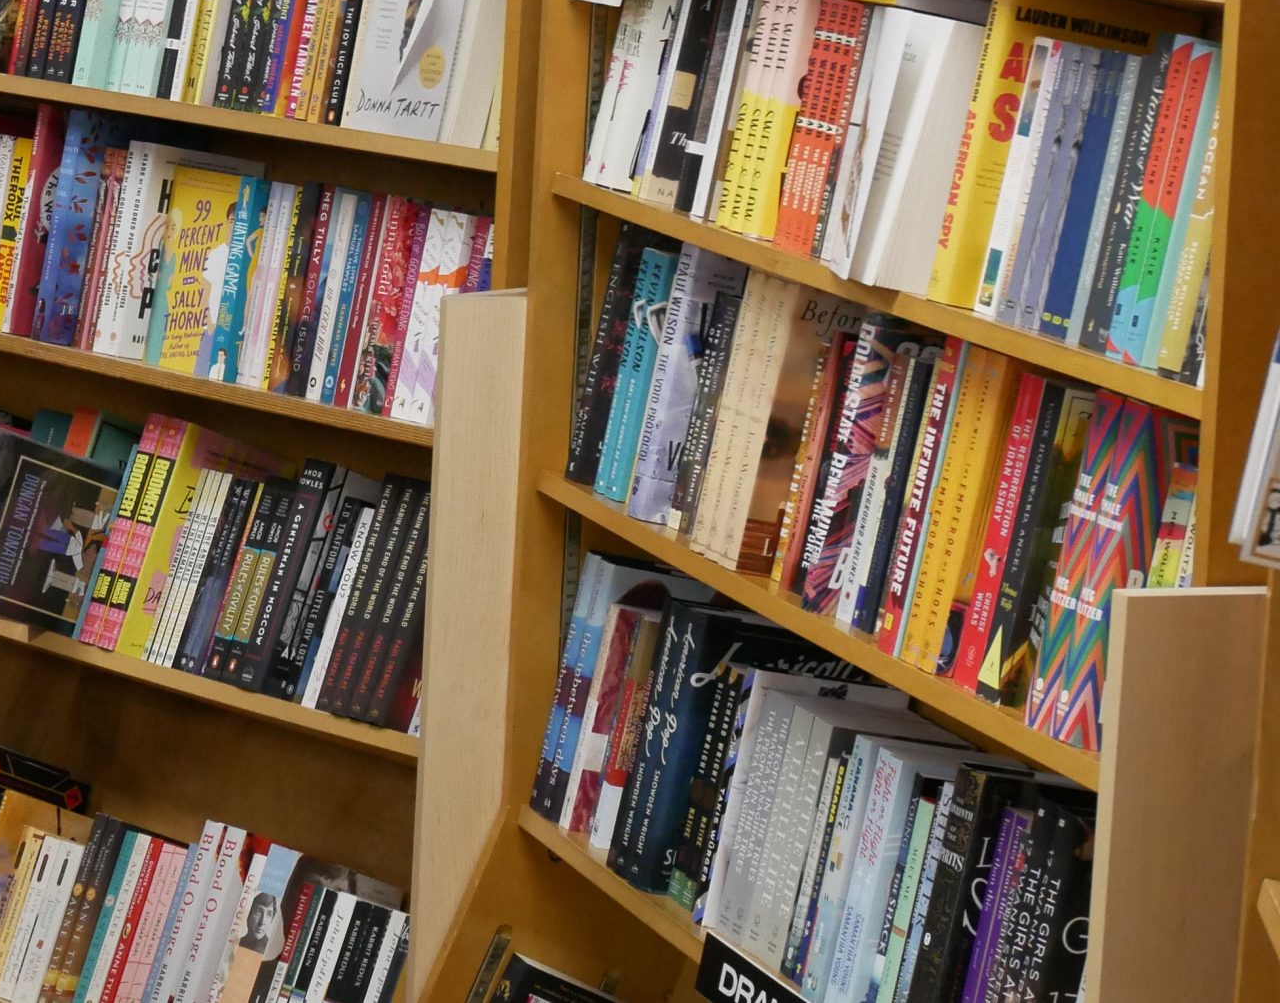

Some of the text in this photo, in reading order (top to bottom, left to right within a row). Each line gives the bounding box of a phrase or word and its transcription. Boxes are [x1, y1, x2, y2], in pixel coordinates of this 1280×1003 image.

[1015, 6, 1150, 48] LAUREN WILKINSON
[290, 48, 308, 105] TAMBLYN
[392, 93, 439, 119] TARTT
[4, 157, 23, 221] THEROUX
[14, 187, 25, 221] PAUL
[938, 110, 977, 249] AMERICAN SPY
[178, 225, 223, 248] PERCENT
[194, 200, 212, 221] 99
[0, 247, 17, 305] MOTHER
[181, 252, 210, 273] MINE
[225, 219, 248, 298] HATING GAME
[292, 192, 331, 372] MEG TILLY SOLACE ISLAND
[164, 309, 208, 331] THORNE
[172, 291, 204, 311] SALLY
[12, 473, 41, 523] DUNCAN
[139, 458, 170, 523] BOOMER1
[891, 383, 946, 596] THE INFINITE FUTURE
[224, 554, 254, 631] RULES CIVILITY
[256, 515, 301, 646] GENTLEMAN IN MOSCOW
[296, 590, 324, 668] LITTLE BOY LOST
[187, 839, 238, 963] Blood Orange
